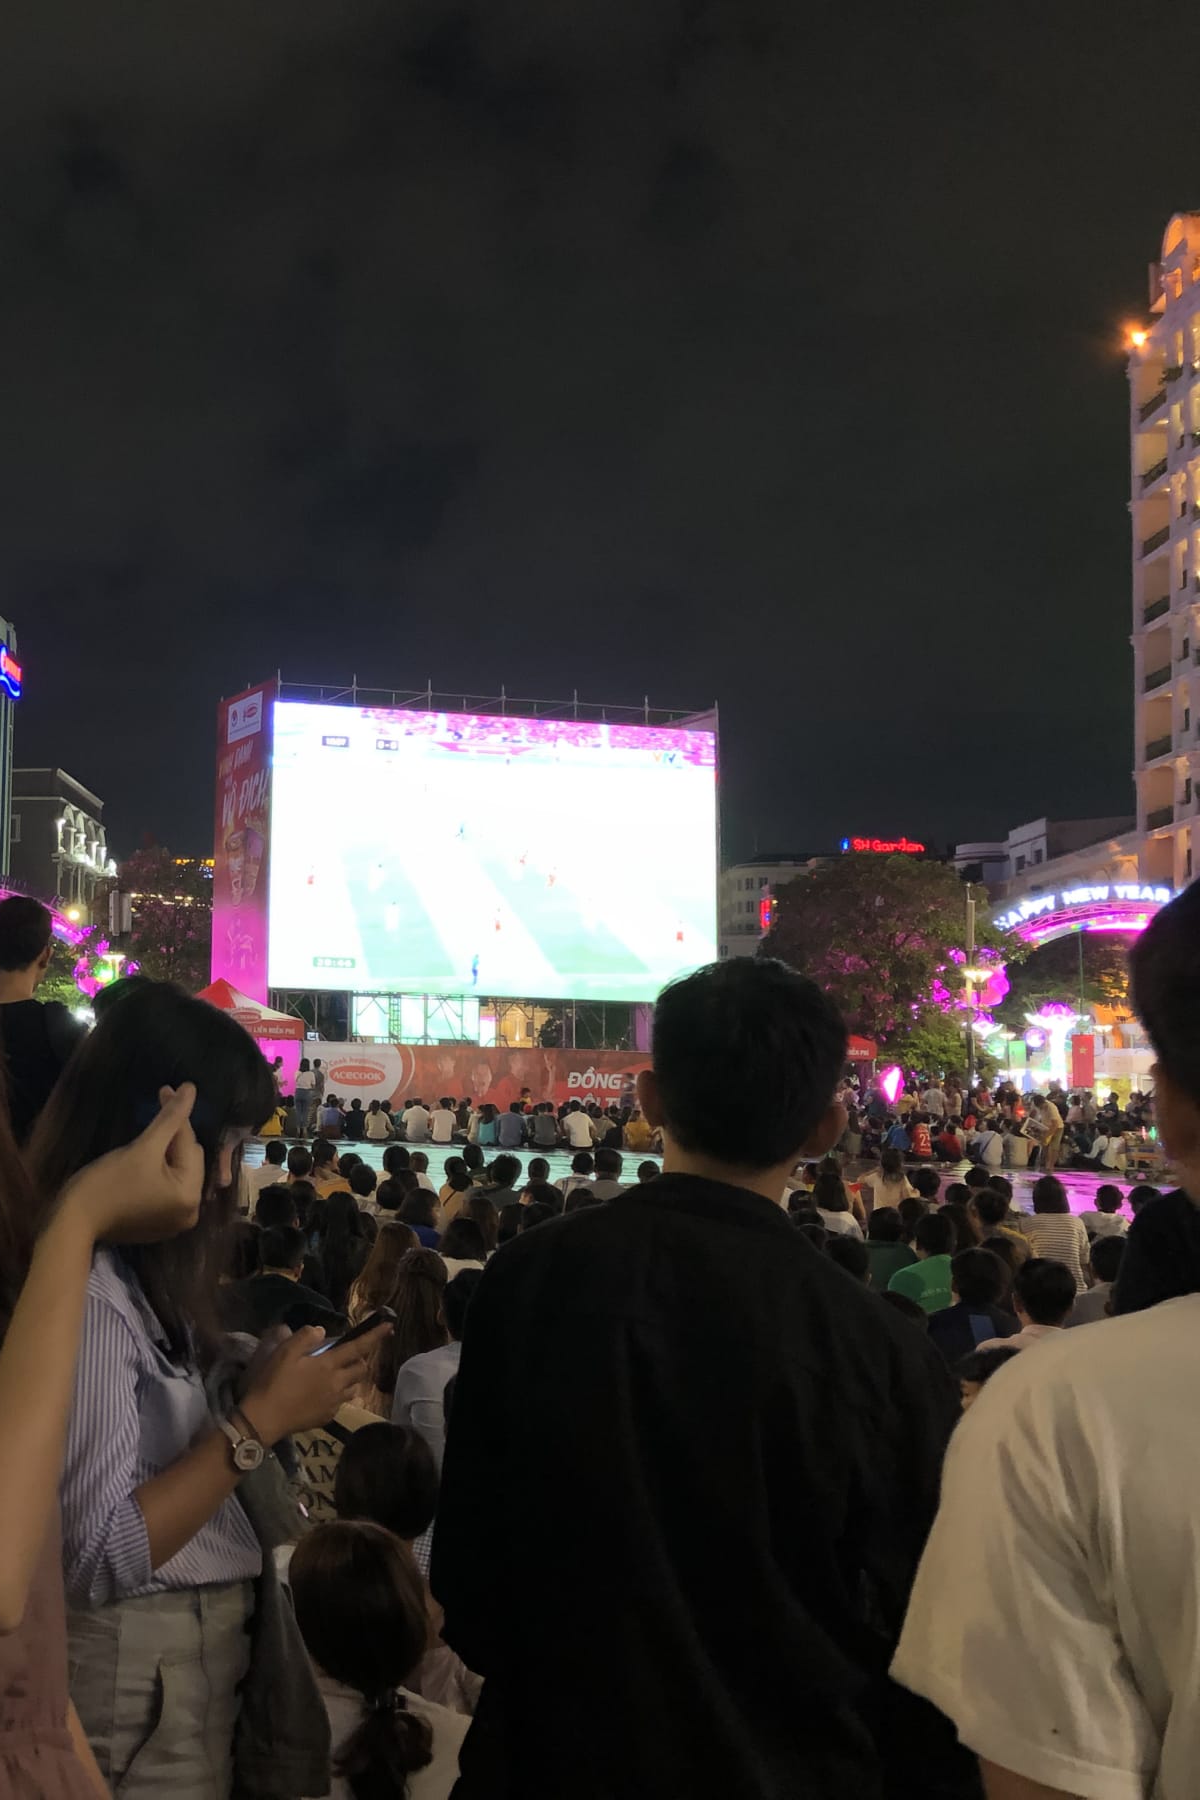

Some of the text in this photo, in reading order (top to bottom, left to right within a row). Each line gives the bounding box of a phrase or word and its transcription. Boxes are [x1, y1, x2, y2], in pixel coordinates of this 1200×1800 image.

[1062, 886, 1109, 905] NEW
[1114, 885, 1171, 902] YEAR
[332, 1070, 382, 1081] ACECOOK
[568, 1066, 622, 1089] ĐỒNG
